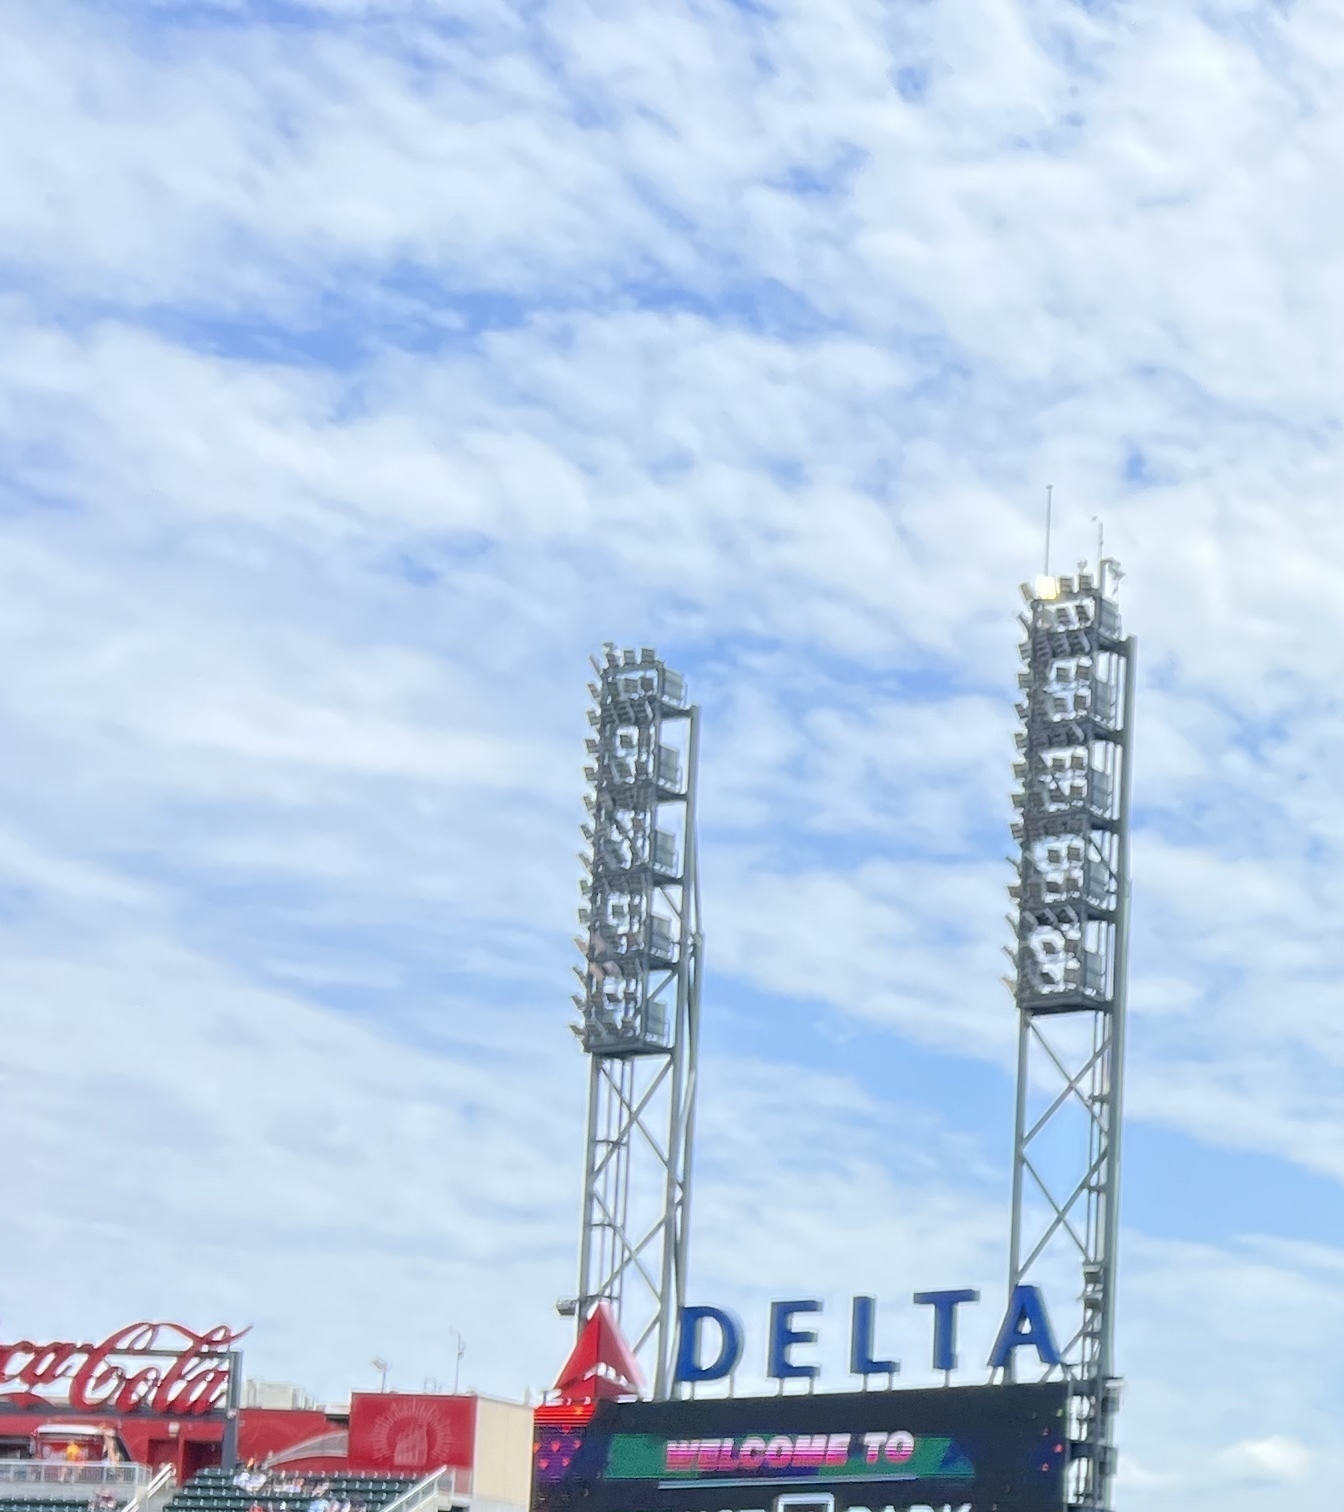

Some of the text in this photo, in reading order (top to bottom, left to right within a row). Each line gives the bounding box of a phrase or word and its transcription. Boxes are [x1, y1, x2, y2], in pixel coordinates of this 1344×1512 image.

[675, 1285, 1063, 1382] DELTA
[664, 1430, 916, 1472] WELCOME TO
